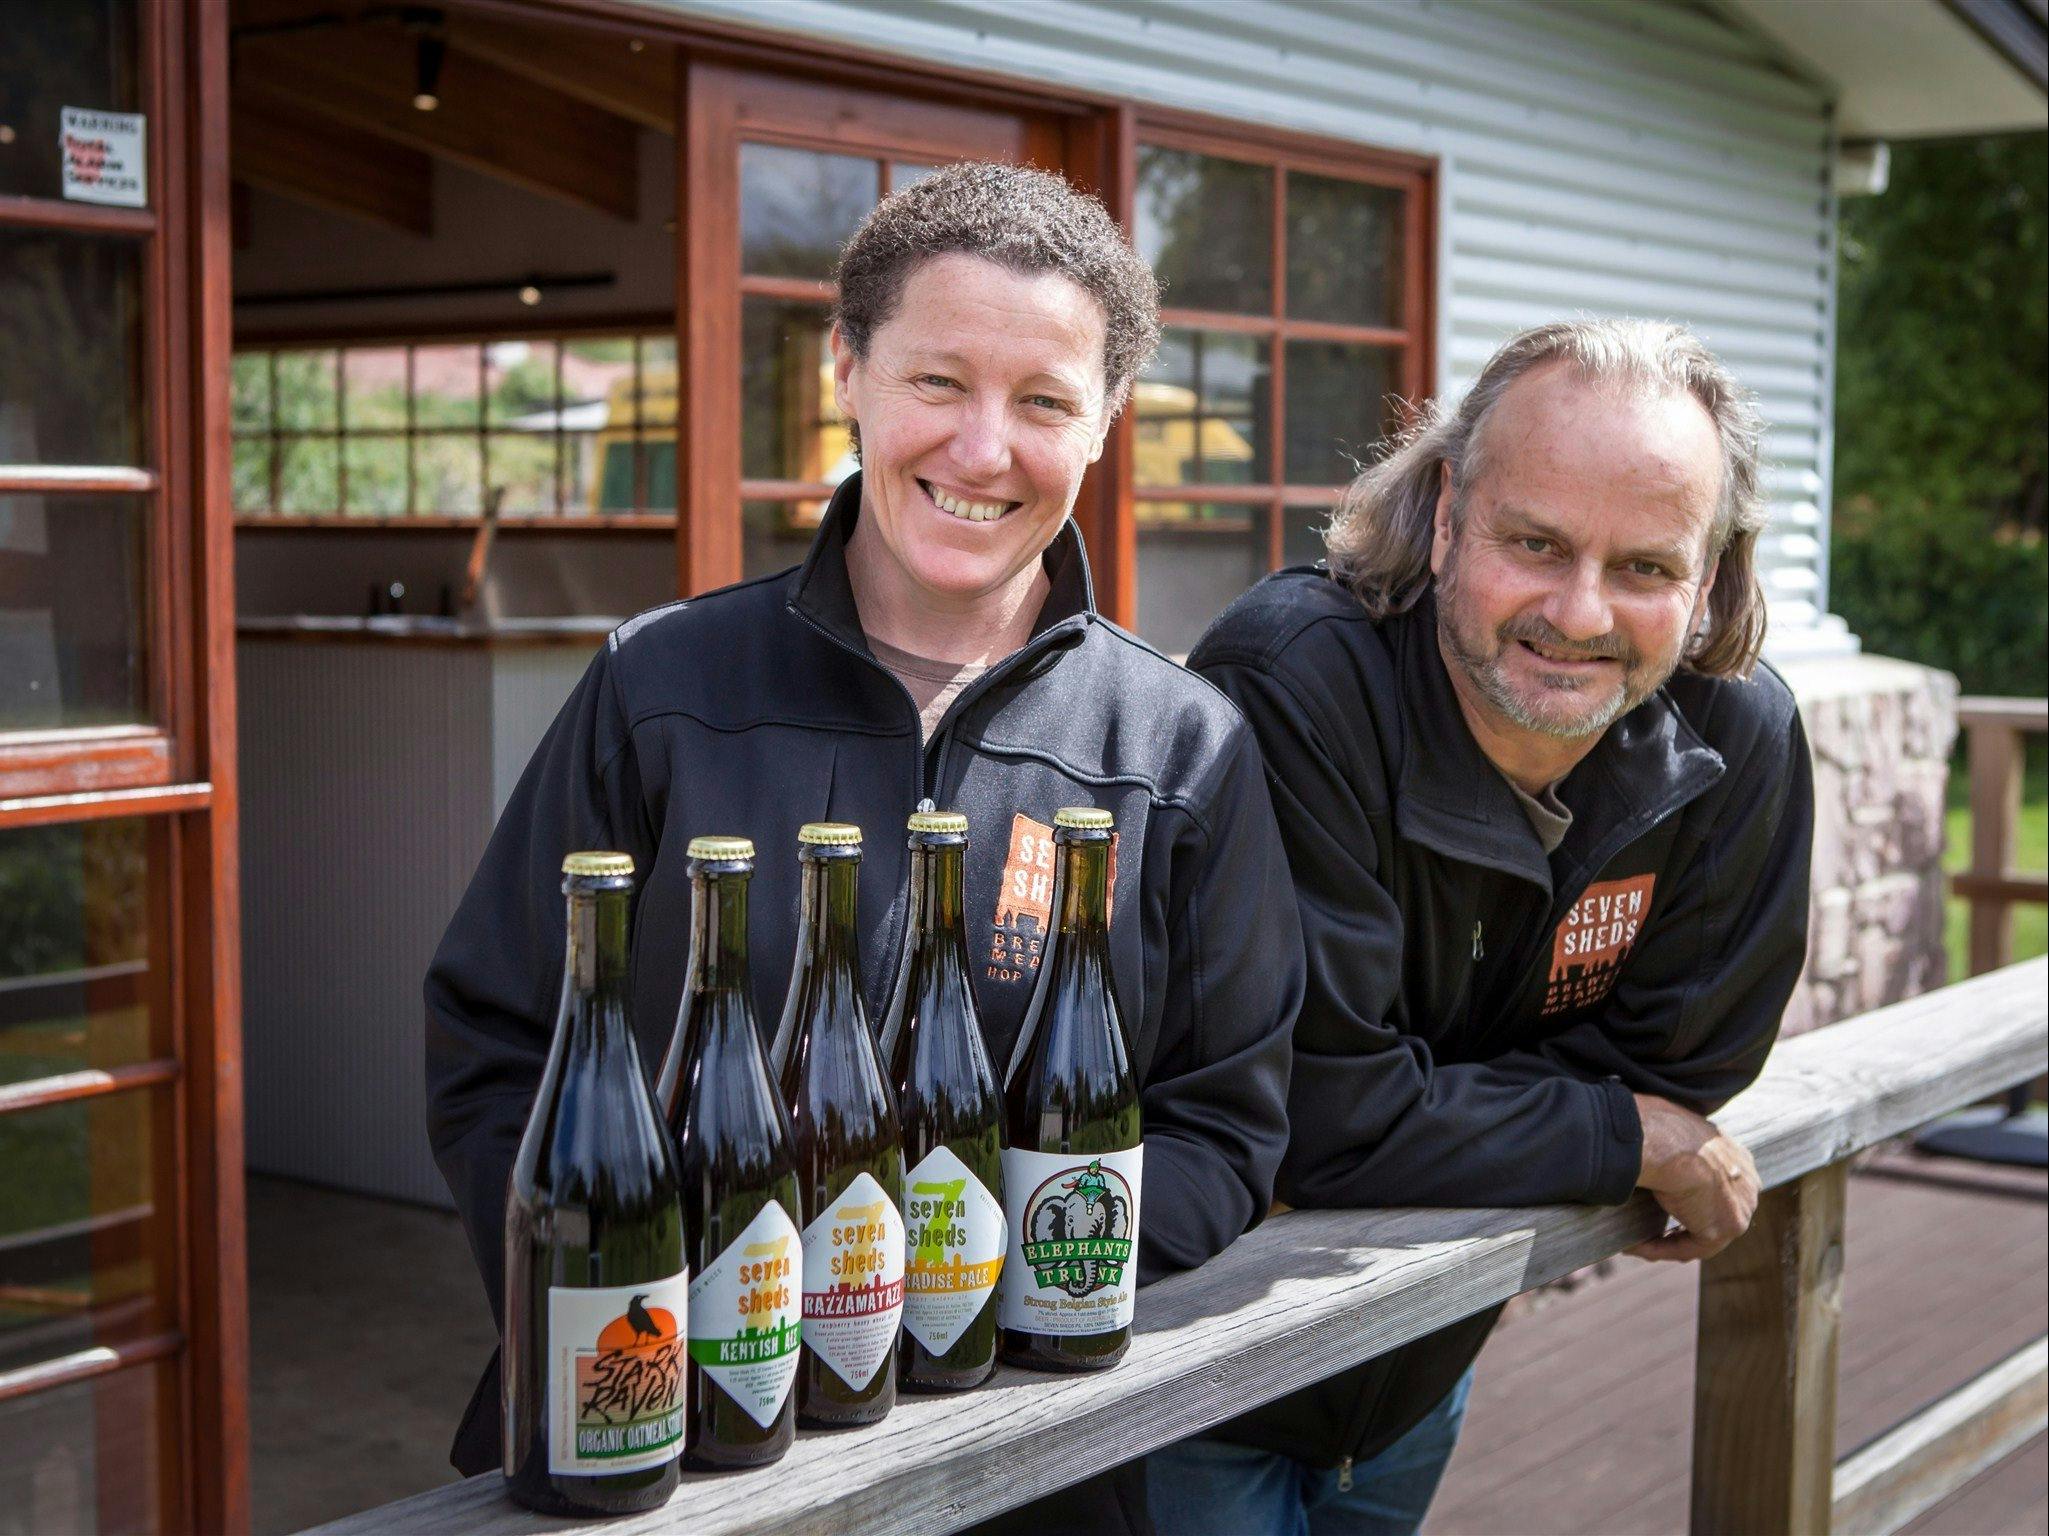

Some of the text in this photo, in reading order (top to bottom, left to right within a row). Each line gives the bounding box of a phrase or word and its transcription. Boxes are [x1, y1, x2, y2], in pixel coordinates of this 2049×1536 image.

[1020, 834, 1050, 869] SE
[1013, 869, 1048, 902] SH
[1567, 890, 1643, 926] SEVEN
[993, 932, 1040, 953] BRE
[1564, 919, 1638, 955] SHEDS
[991, 949, 1041, 969] MEA
[987, 966, 1022, 982] HOP
[909, 1199, 966, 1219] seven
[831, 1223, 886, 1247] seven
[908, 1223, 967, 1248] sheds
[830, 1248, 885, 1276] sheds
[1026, 1240, 1129, 1261] ELEPHANTS
[739, 1257, 790, 1286] seven
[905, 1267, 989, 1291] RADISE PALE
[1042, 1268, 1118, 1285] TRUNK
[738, 1284, 790, 1315] sheds
[804, 1283, 902, 1316] RAZZAMATAZZ
[1023, 1290, 1128, 1311] Strong Belgian Style Ale
[720, 1336, 778, 1362] KENTISH
[784, 1326, 799, 1352] ALE
[593, 1340, 685, 1386] STARK
[578, 1426, 626, 1454] ORGANIC
[627, 1420, 668, 1450] OATMEAL
